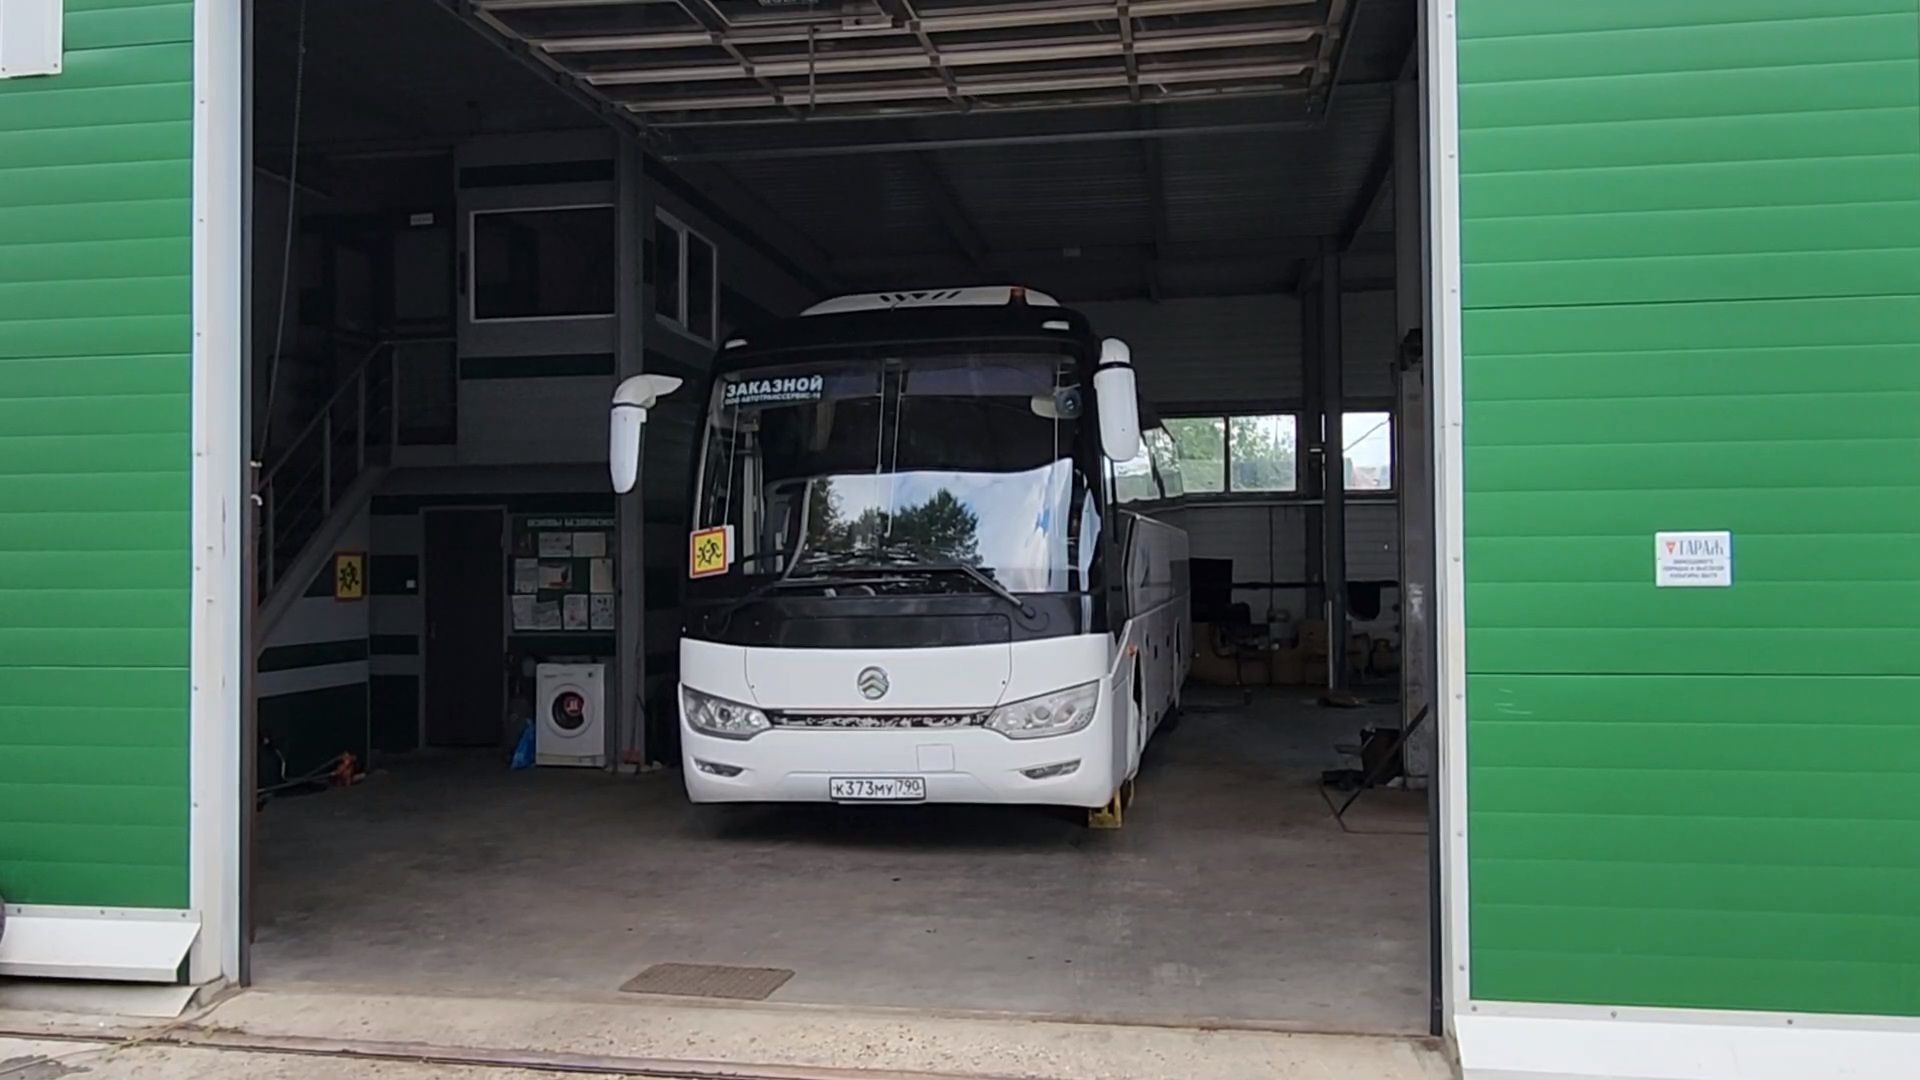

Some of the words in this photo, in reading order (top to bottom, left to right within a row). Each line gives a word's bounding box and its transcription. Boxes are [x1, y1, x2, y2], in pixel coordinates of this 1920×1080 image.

[726, 374, 824, 398] ЗАКАЗНОЙ
[836, 781, 893, 796] К373МУ
[898, 780, 920, 792] 790
